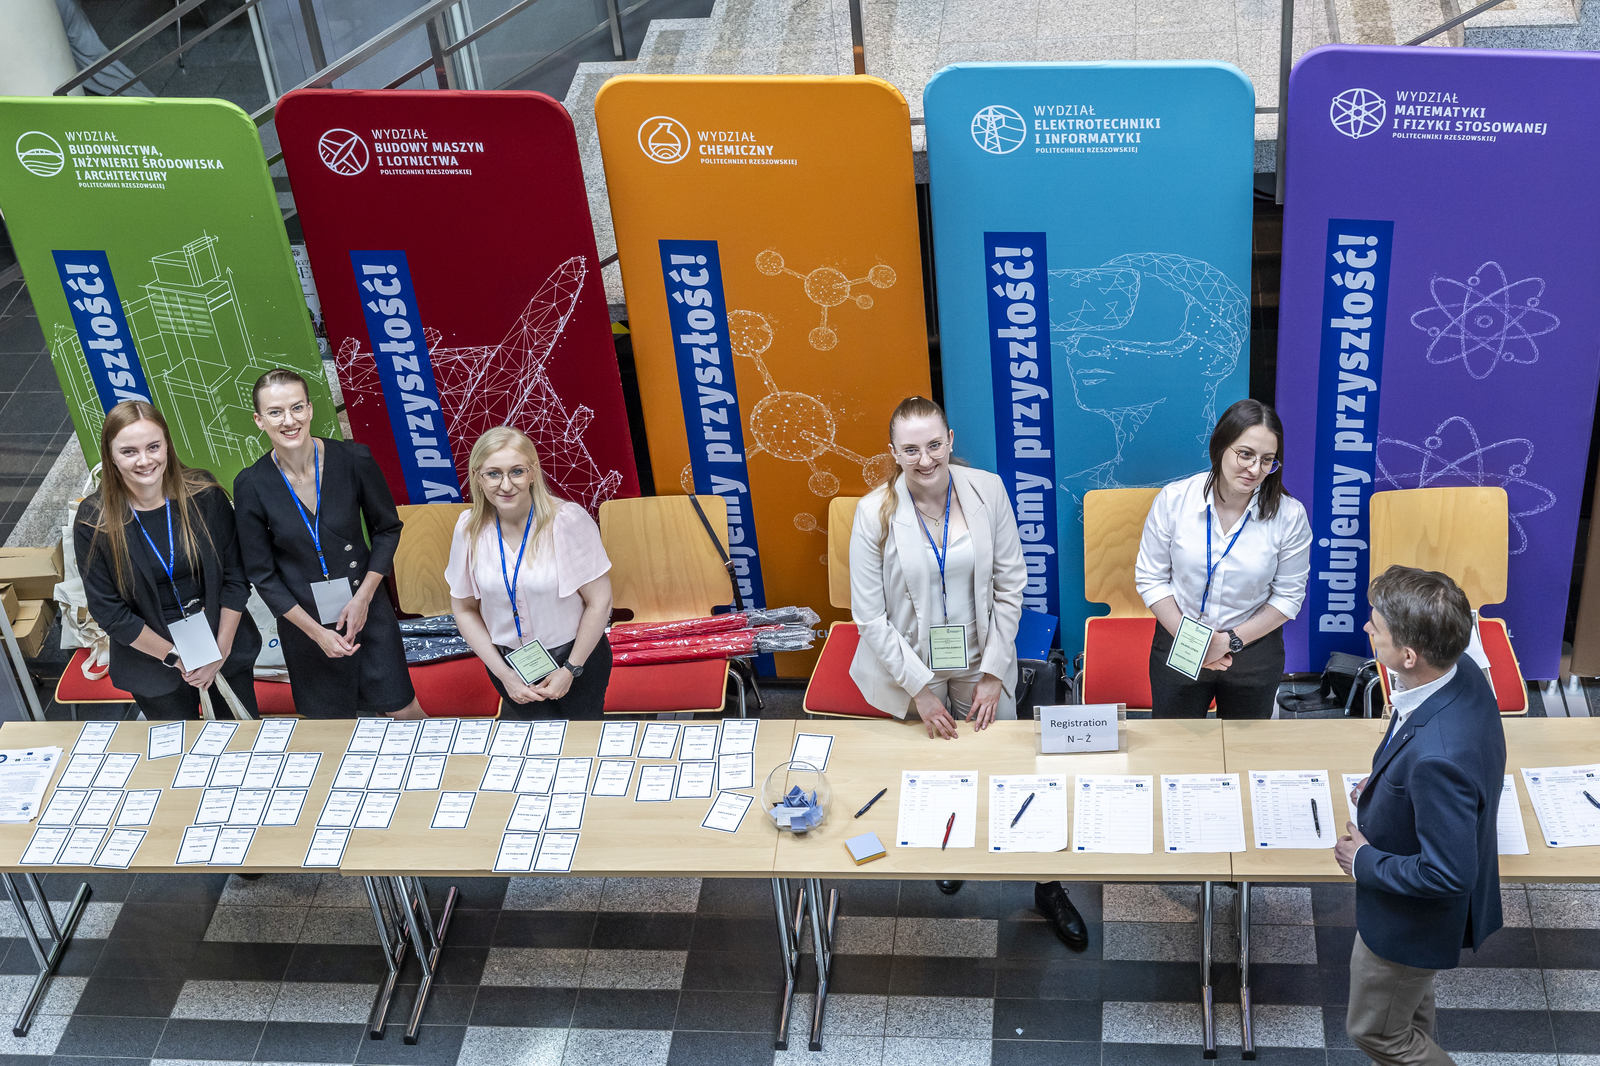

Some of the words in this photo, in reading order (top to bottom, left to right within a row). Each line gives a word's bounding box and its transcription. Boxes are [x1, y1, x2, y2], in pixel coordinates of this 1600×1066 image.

[1396, 90, 1459, 104] WYDZIAŁ
[1033, 104, 1096, 116] WYDZIAŁ
[1394, 104, 1486, 119] MATEMATYKI
[1034, 118, 1161, 130] ELEKTROTECHNIKI
[1393, 118, 1399, 129] I
[1403, 119, 1451, 131] FIZYKI
[1455, 120, 1548, 136] STOSOWANEJ
[64, 131, 119, 142] WYDZIAŁ
[371, 128, 428, 140] WYDZIAŁ
[697, 131, 757, 142] WYDZIAŁ
[1035, 133, 1041, 144] I
[1045, 132, 1141, 144] INFORMATYKI
[1392, 132, 1442, 140] POLITECHNIKI
[1444, 134, 1497, 143] RZESZOWSKIEJ
[68, 144, 163, 157] BUDOWNICTWA,
[374, 142, 428, 153] BUDOWY
[432, 142, 484, 153] MASZYN
[699, 144, 774, 156] CHEMICZNY
[1086, 146, 1138, 154] RZESZOWSKIEJ
[73, 155, 140, 169] INŻYNIERII
[142, 156, 224, 170] ŚRODOWISKA
[377, 155, 384, 166] I
[386, 155, 459, 166] LOTNICTWA
[749, 158, 798, 166] RZESZOWSKIEJ
[75, 171, 81, 181] I
[84, 171, 168, 182] ARCHITEKTURY
[426, 168, 472, 176] RZESZOWSKIEJ
[121, 182, 165, 190] RZESZOWSKIEJ
[65, 263, 151, 405] yszłość!
[1330, 234, 1379, 452] przyszłość!
[668, 253, 746, 463] przyszłość!
[991, 246, 1051, 459] przyszłość!
[361, 264, 452, 468] przyszłość!
[1318, 463, 1372, 633] Budujemy
[1050, 719, 1107, 729] Registration
[1067, 735, 1075, 743] N
